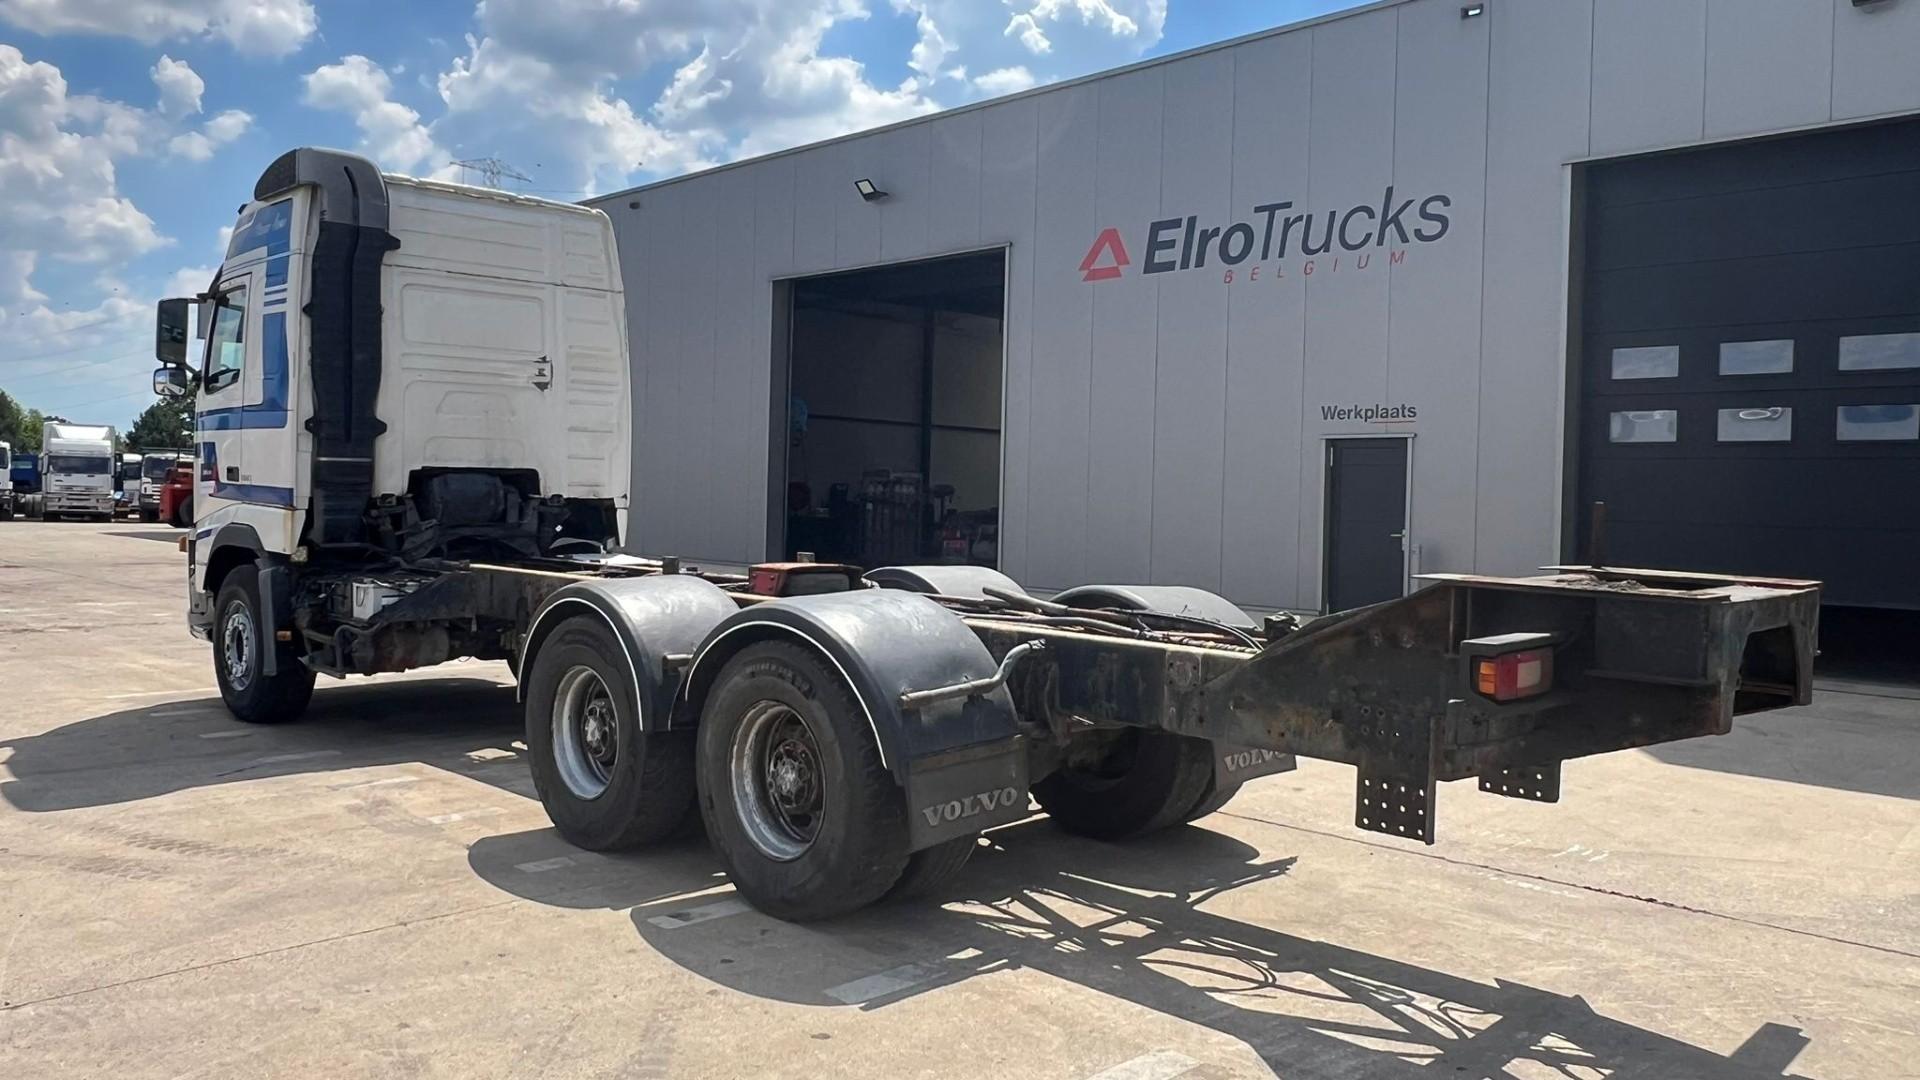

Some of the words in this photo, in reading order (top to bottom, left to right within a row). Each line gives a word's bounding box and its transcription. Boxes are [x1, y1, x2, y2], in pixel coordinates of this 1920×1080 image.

[1143, 186, 1452, 275] ElroTrucks
[1223, 250, 1407, 284] BELGIUM
[1321, 404, 1417, 422] Werkplaats
[922, 787, 1018, 826] VOLVO
